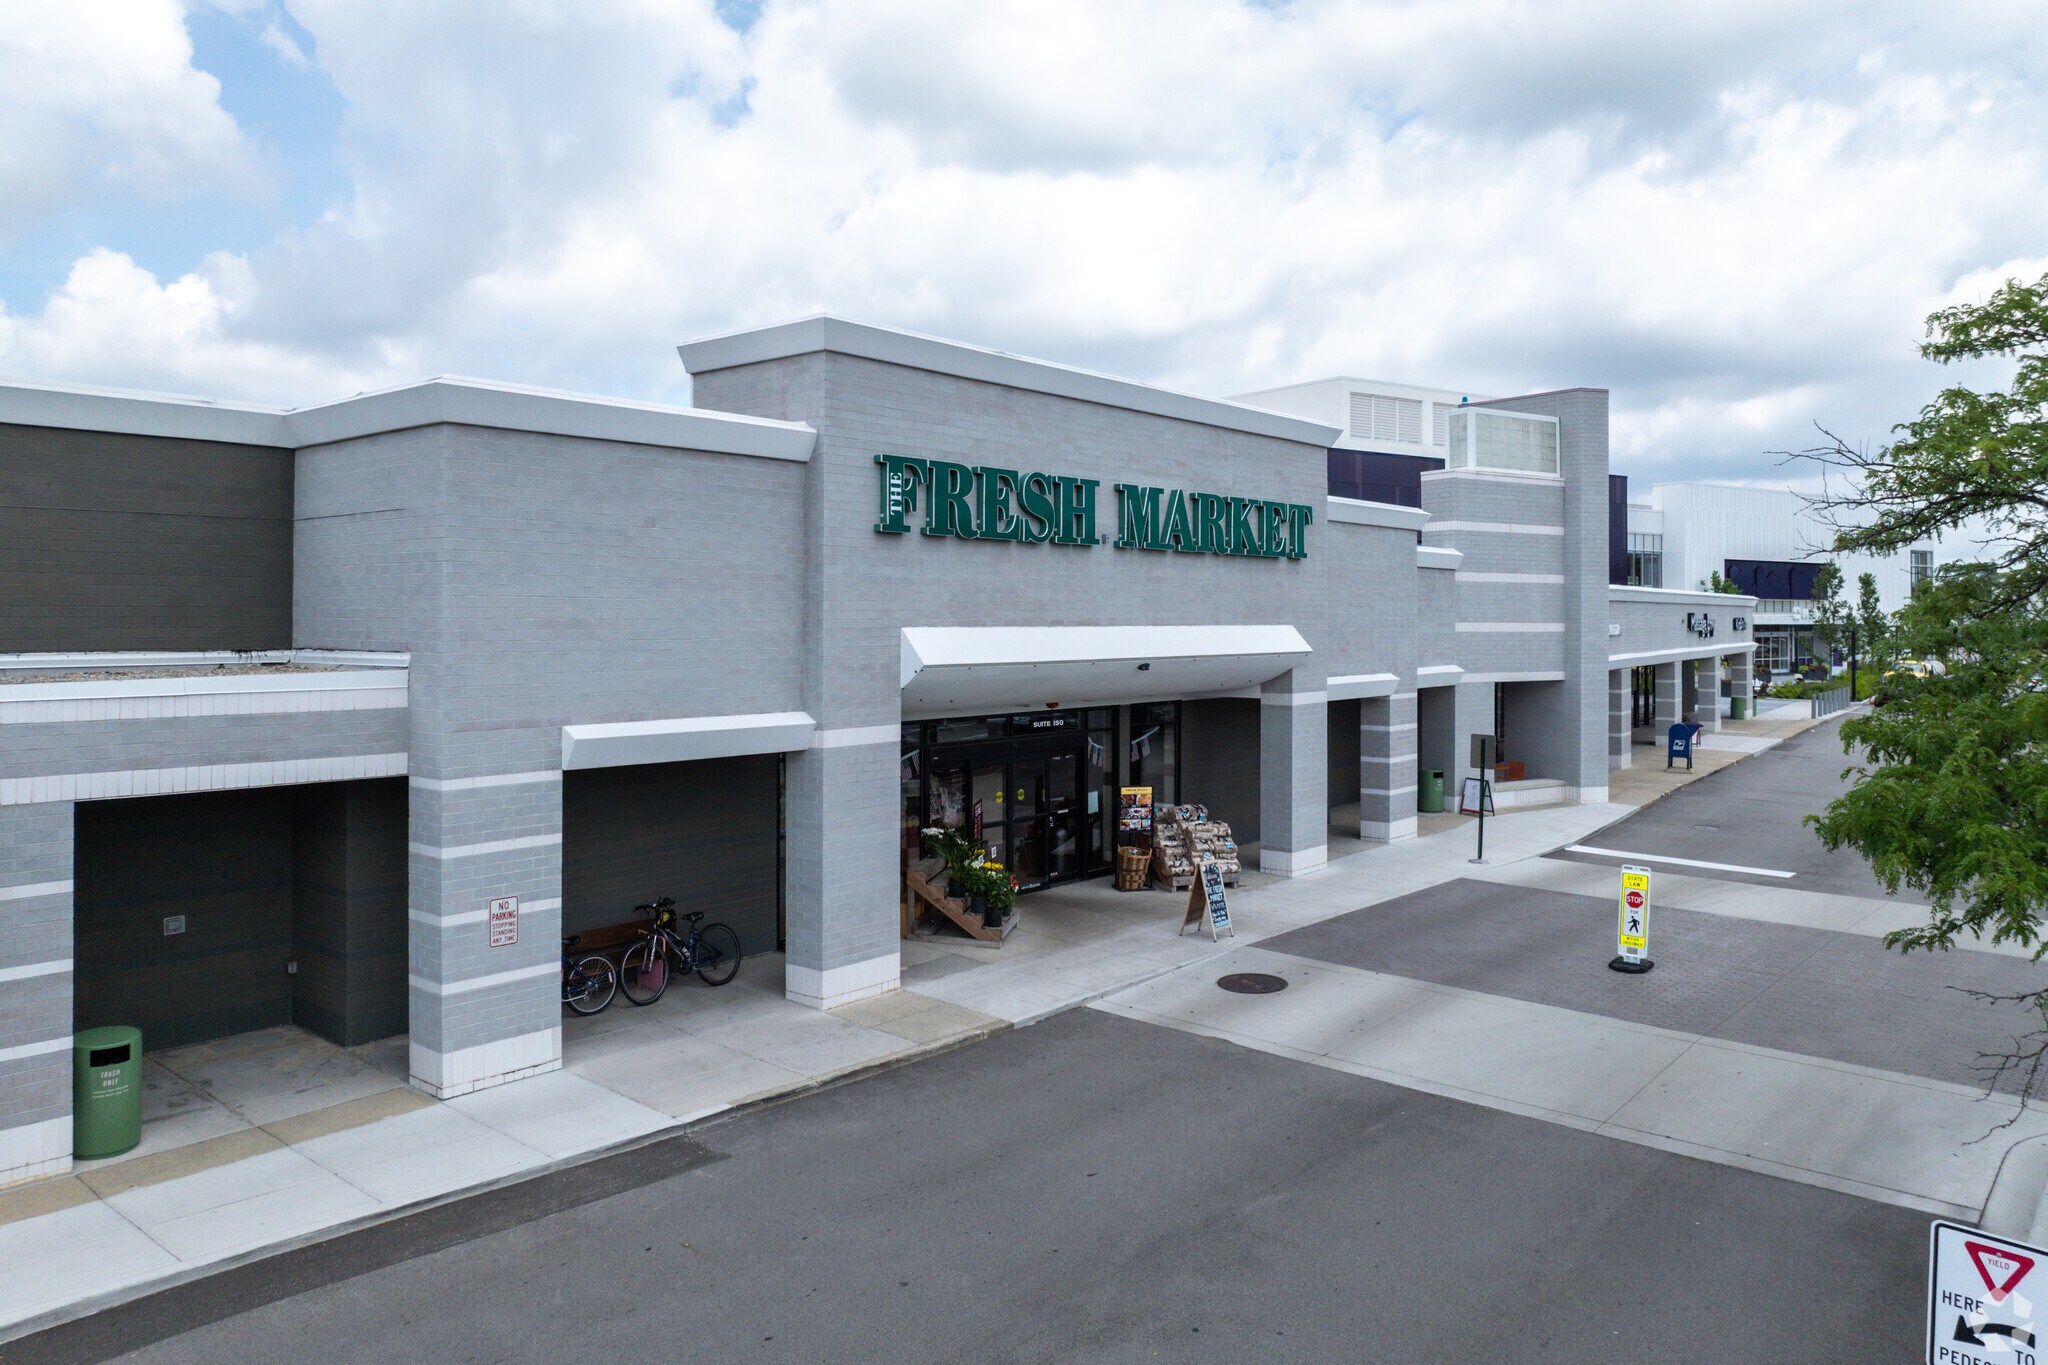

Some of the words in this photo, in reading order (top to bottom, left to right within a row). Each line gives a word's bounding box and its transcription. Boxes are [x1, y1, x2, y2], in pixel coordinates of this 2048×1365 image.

[890, 472, 902, 515] THE
[874, 454, 1100, 545] FRESH
[1114, 483, 1313, 558] MARKET
[1627, 875, 1643, 883] STATE
[1626, 895, 1644, 904] STOP
[498, 901, 509, 911] NO
[492, 910, 516, 922] PARKING
[492, 920, 516, 930] STOPPING
[492, 928, 516, 938] STANDING
[100, 1069, 121, 1079] TRASH
[102, 1078, 119, 1087] ONLY
[1987, 1257, 2010, 1270] YIELD
[1942, 1290, 1984, 1315] HERE
[1939, 1346, 1991, 1365] PEDE
[2014, 1349, 2035, 1365] TO
